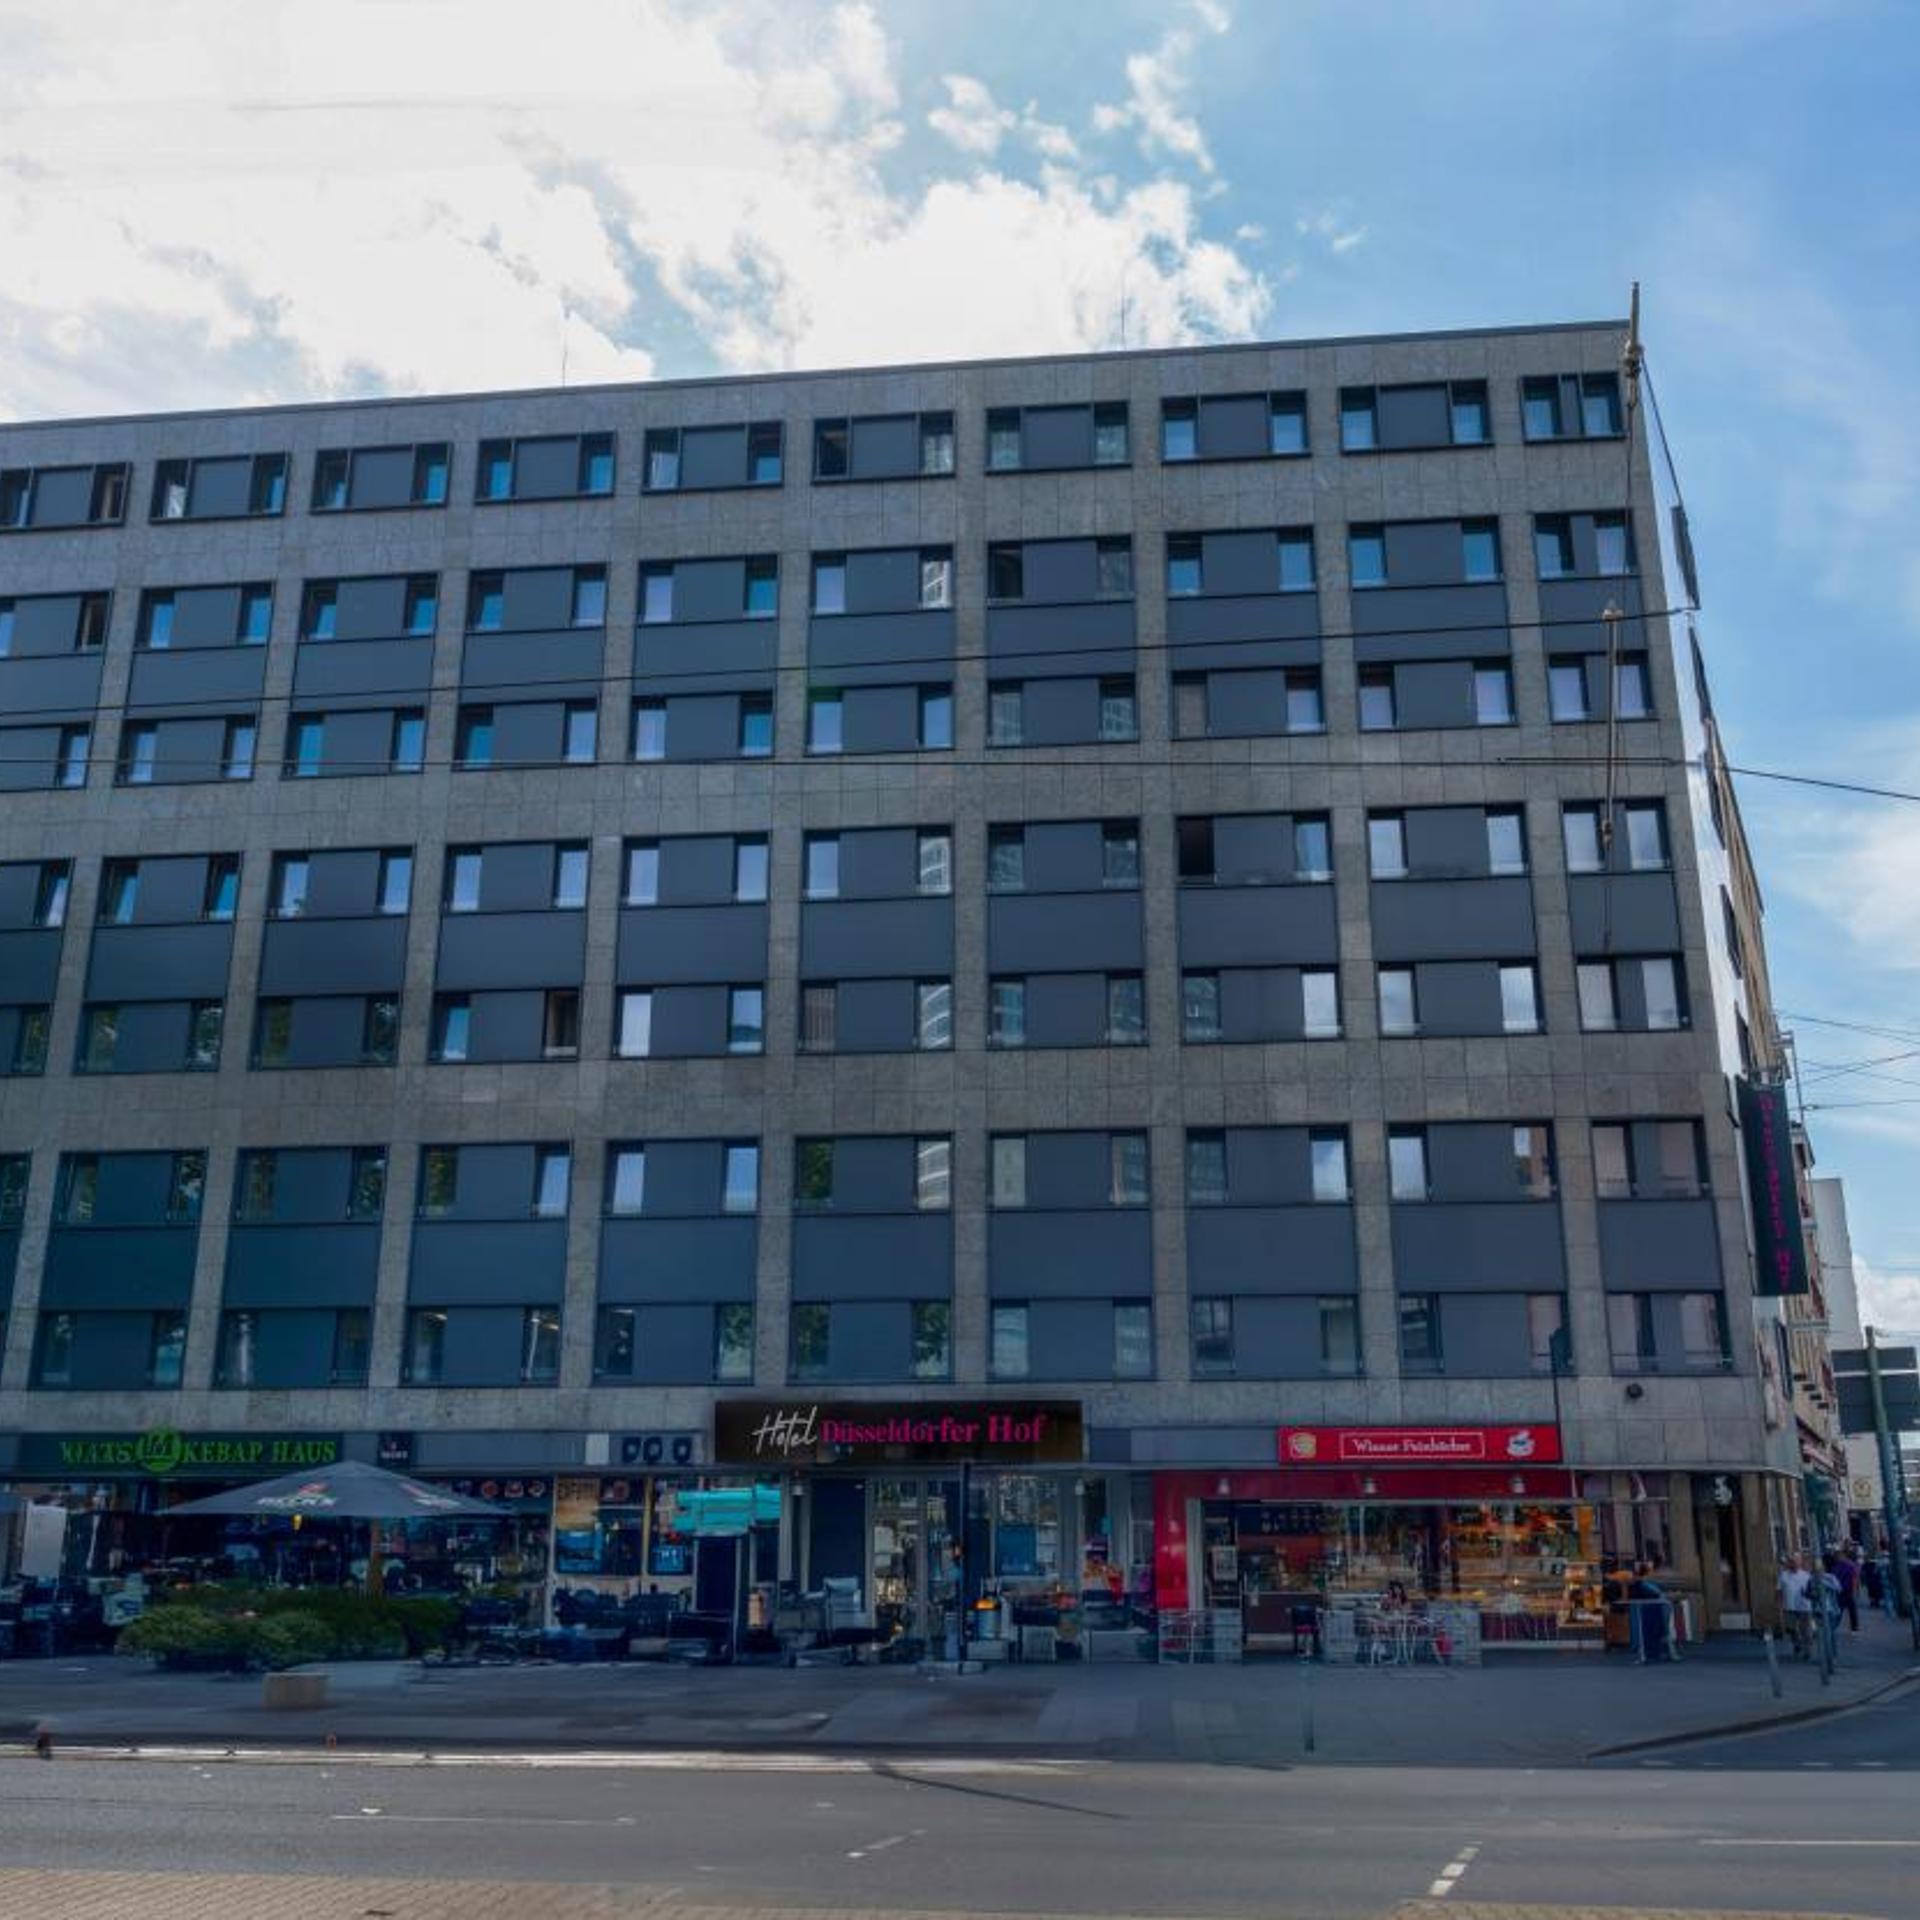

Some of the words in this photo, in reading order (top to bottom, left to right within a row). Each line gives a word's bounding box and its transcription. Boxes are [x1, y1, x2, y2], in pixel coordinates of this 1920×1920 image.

[751, 1405, 818, 1456] Hotel
[820, 1412, 981, 1444] Düsseldorfer
[987, 1411, 1048, 1443] Hof
[182, 1441, 263, 1464] KEBAP
[271, 1440, 336, 1464] HAUS
